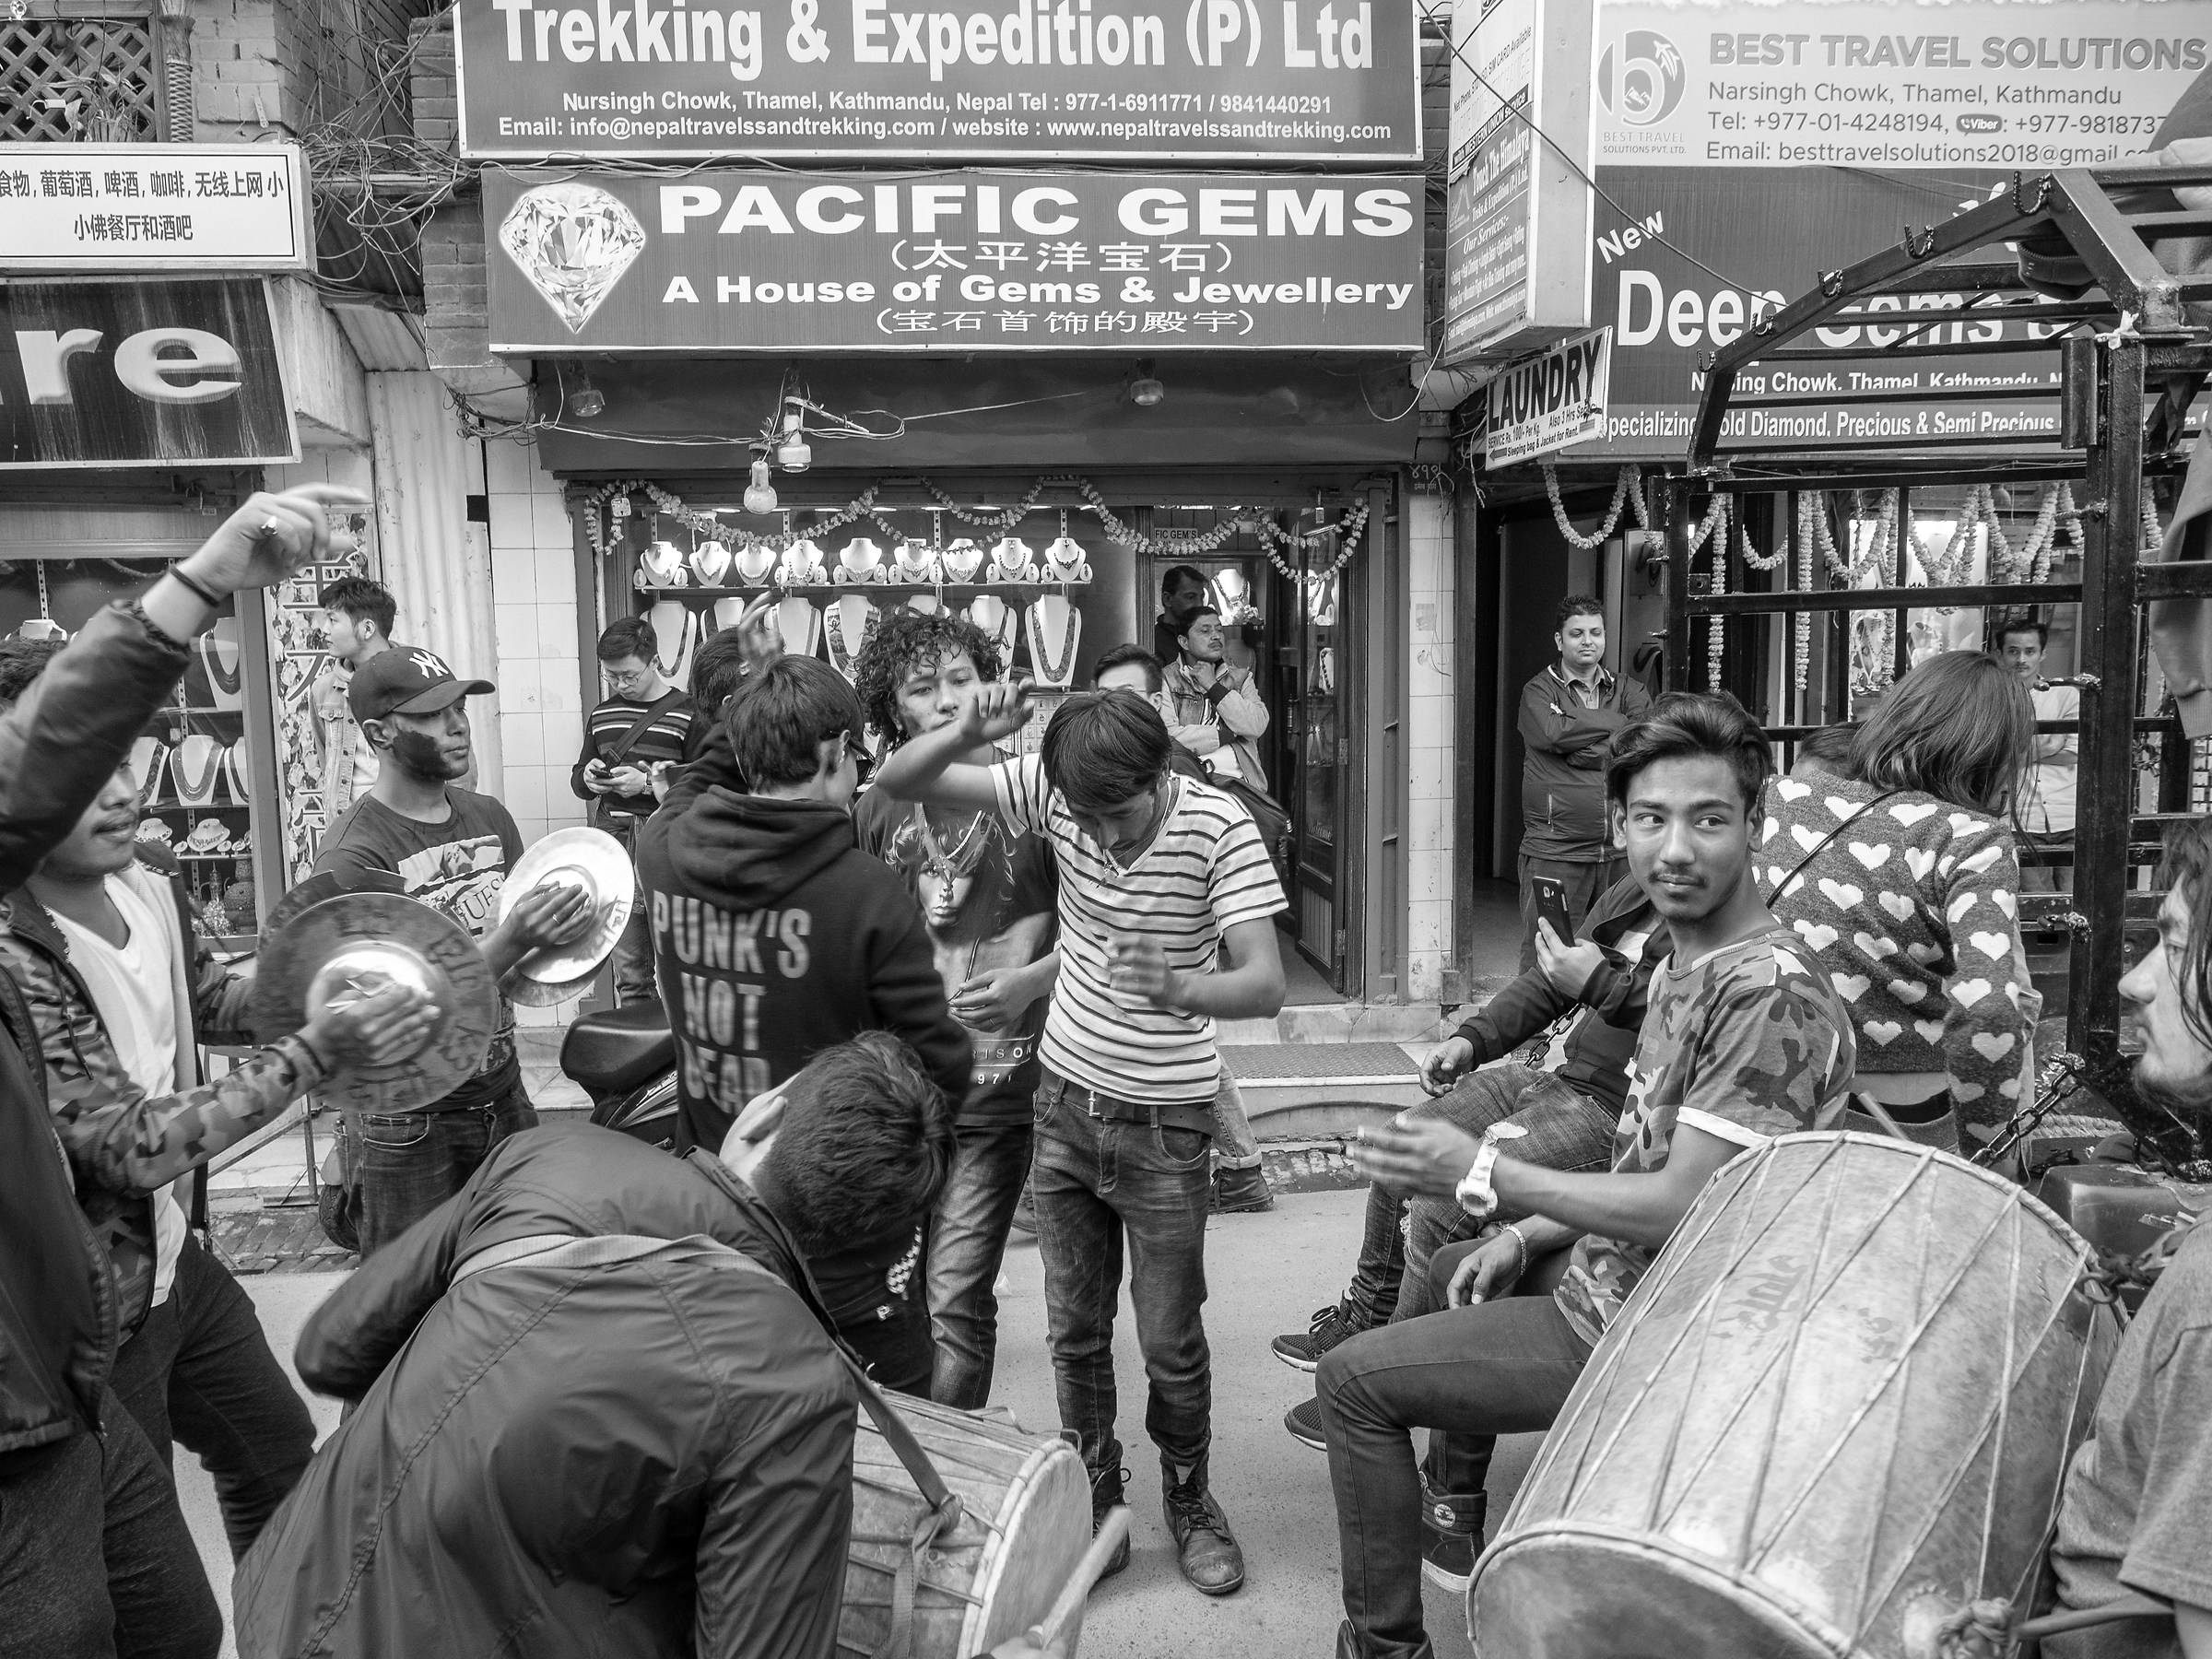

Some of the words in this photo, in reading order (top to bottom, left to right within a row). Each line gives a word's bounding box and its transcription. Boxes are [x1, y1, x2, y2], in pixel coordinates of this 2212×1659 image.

[493, 0, 762, 81] Trekking
[786, 0, 830, 63] &
[853, 0, 1164, 81] Expedition
[1186, 0, 1261, 66] (P)
[1711, 33, 1809, 65] BEST
[1821, 34, 1971, 68] TRAVEL
[1981, 37, 2206, 70] SOLUTIONS
[564, 91, 654, 114] Nursingh
[662, 91, 737, 112] Chowk,
[743, 91, 822, 112] Thamel,
[830, 91, 949, 112] Kathmandu,
[958, 93, 1012, 114] Nepal
[1018, 93, 1047, 110] Tel
[1065, 93, 1202, 112] 977-1-6911771
[1220, 95, 1330, 113] 9841440291
[1710, 81, 1806, 104] Narsingh
[1815, 83, 1893, 104] Chowk,
[1903, 84, 1988, 106] Thamel,
[1996, 85, 2122, 104] Kathmandu
[500, 117, 562, 135] Email:
[571, 116, 935, 139] info@nepaltravelssandtrekking.com
[952, 119, 1029, 135] website
[1047, 119, 1390, 140] www.nepaltravelssandtrekking.com
[1603, 131, 1633, 142] BEST
[1639, 132, 1685, 143] TRAVEL
[1708, 112, 1746, 130] Tel:
[1754, 112, 1948, 135] +977-01-4248194,
[2016, 114, 2167, 135] +977-981873
[1500, 126, 1530, 173] Himalaya
[1603, 146, 1650, 154] SOLUTIONS
[1707, 141, 1770, 160] Email:
[660, 185, 1079, 235] PACIFIC
[1118, 186, 1413, 236] GEMS
[75, 214, 194, 241] 小佛餐厅和酒吧
[1596, 210, 1665, 265] New
[891, 240, 1232, 273] (太平洋宝石)
[1464, 232, 1477, 254] Our
[663, 276, 700, 302] A
[717, 276, 875, 302] House
[892, 275, 942, 301] of
[960, 276, 1100, 302] Gems
[1120, 276, 1156, 302] &
[1173, 277, 1413, 311] Jewellery
[0, 327, 242, 406] re
[1488, 334, 1603, 433] LAUNDRY
[1548, 413, 1560, 429] Also
[1566, 407, 1575, 423] Hrs
[1837, 411, 1911, 436] Precious
[1916, 411, 1929, 434] &
[1934, 411, 1976, 432] Semi
[1507, 441, 1526, 457] Sleeping
[1526, 440, 1535, 453] bag
[1540, 433, 1556, 447] Jacket
[1557, 430, 1565, 442] for
[653, 889, 812, 979] PUNK'S
[681, 971, 767, 1051] NOT
